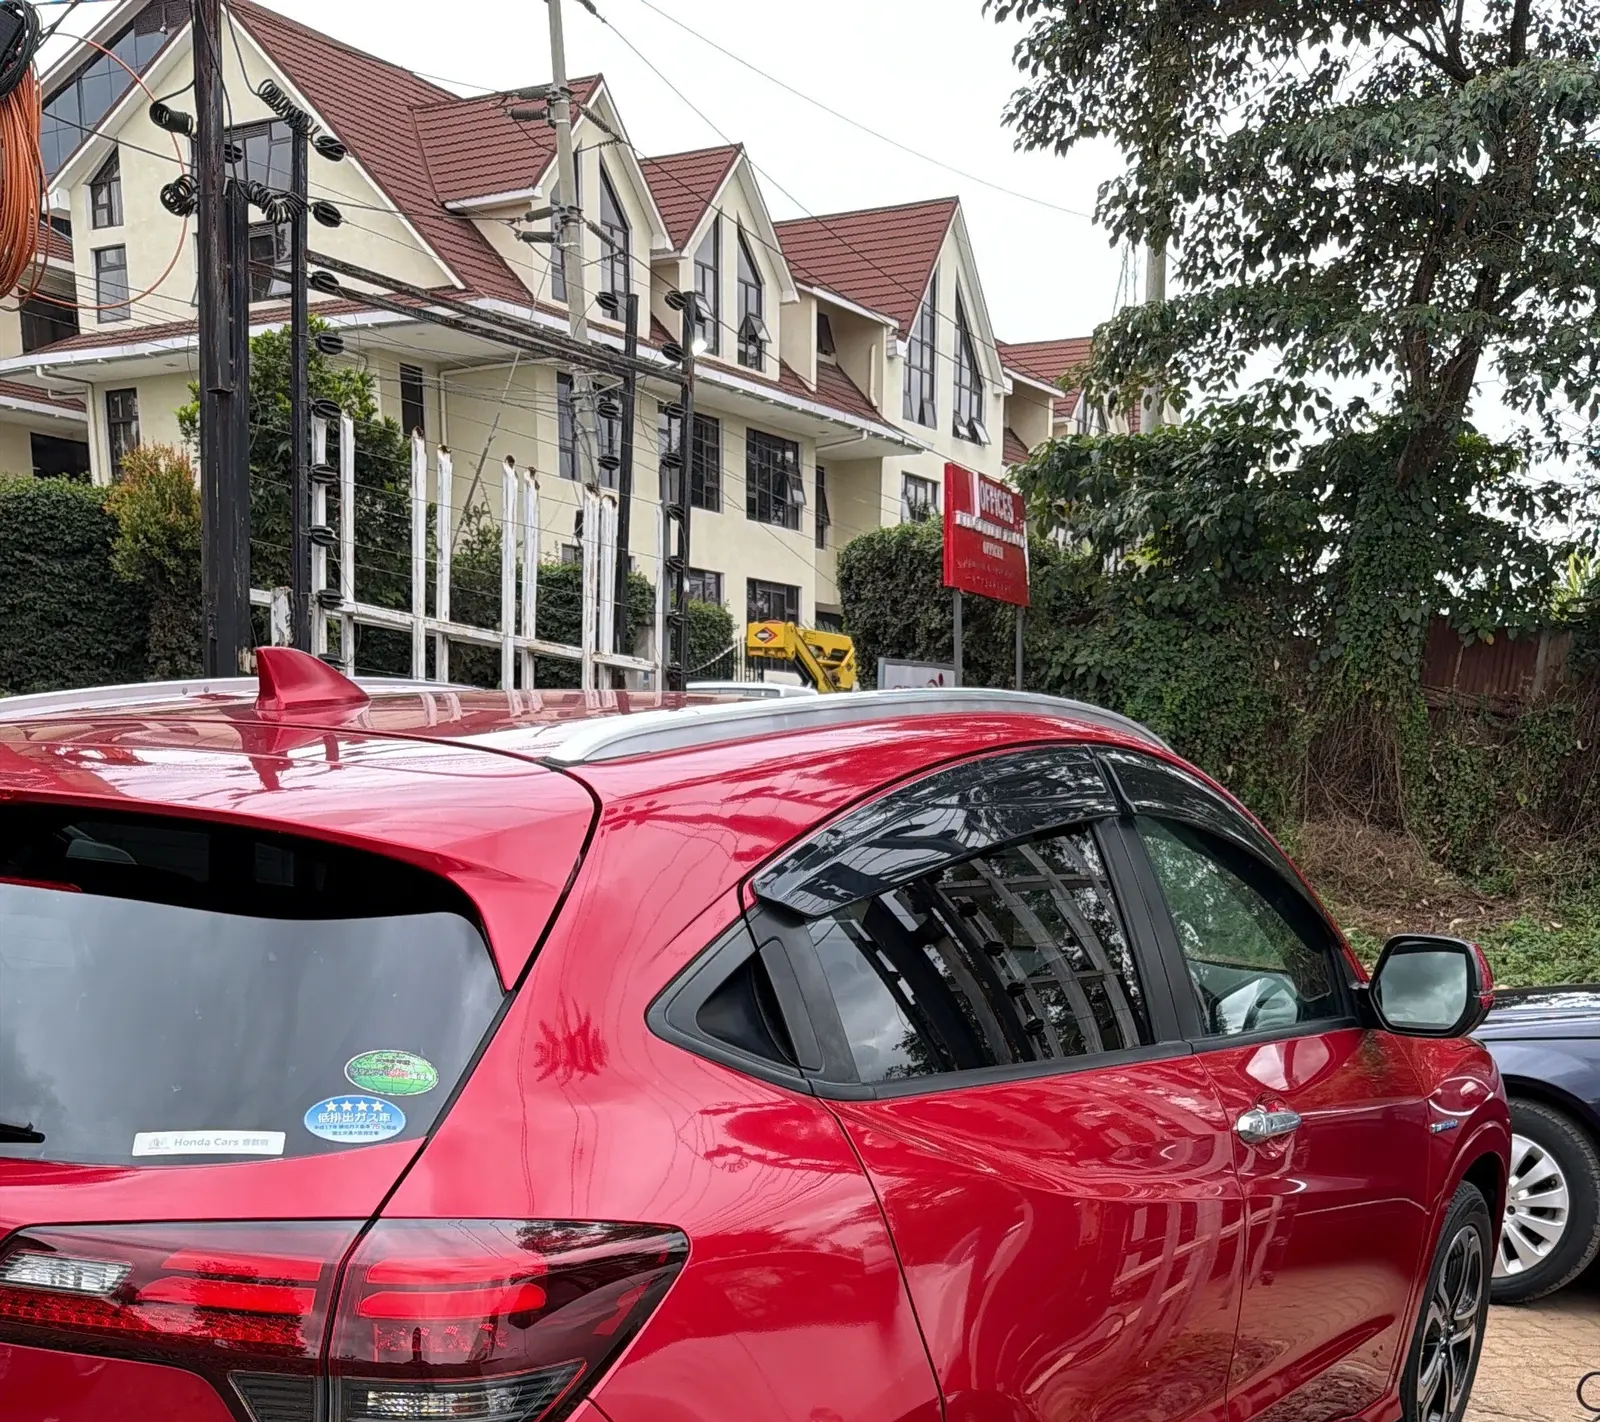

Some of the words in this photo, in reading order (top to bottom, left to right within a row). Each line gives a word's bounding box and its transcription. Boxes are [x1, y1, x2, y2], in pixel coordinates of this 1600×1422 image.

[979, 480, 1014, 525] OFFICES
[317, 1111, 393, 1124] 低排出ガス車
[174, 1138, 211, 1147] Honda
[213, 1137, 239, 1147] Cars
